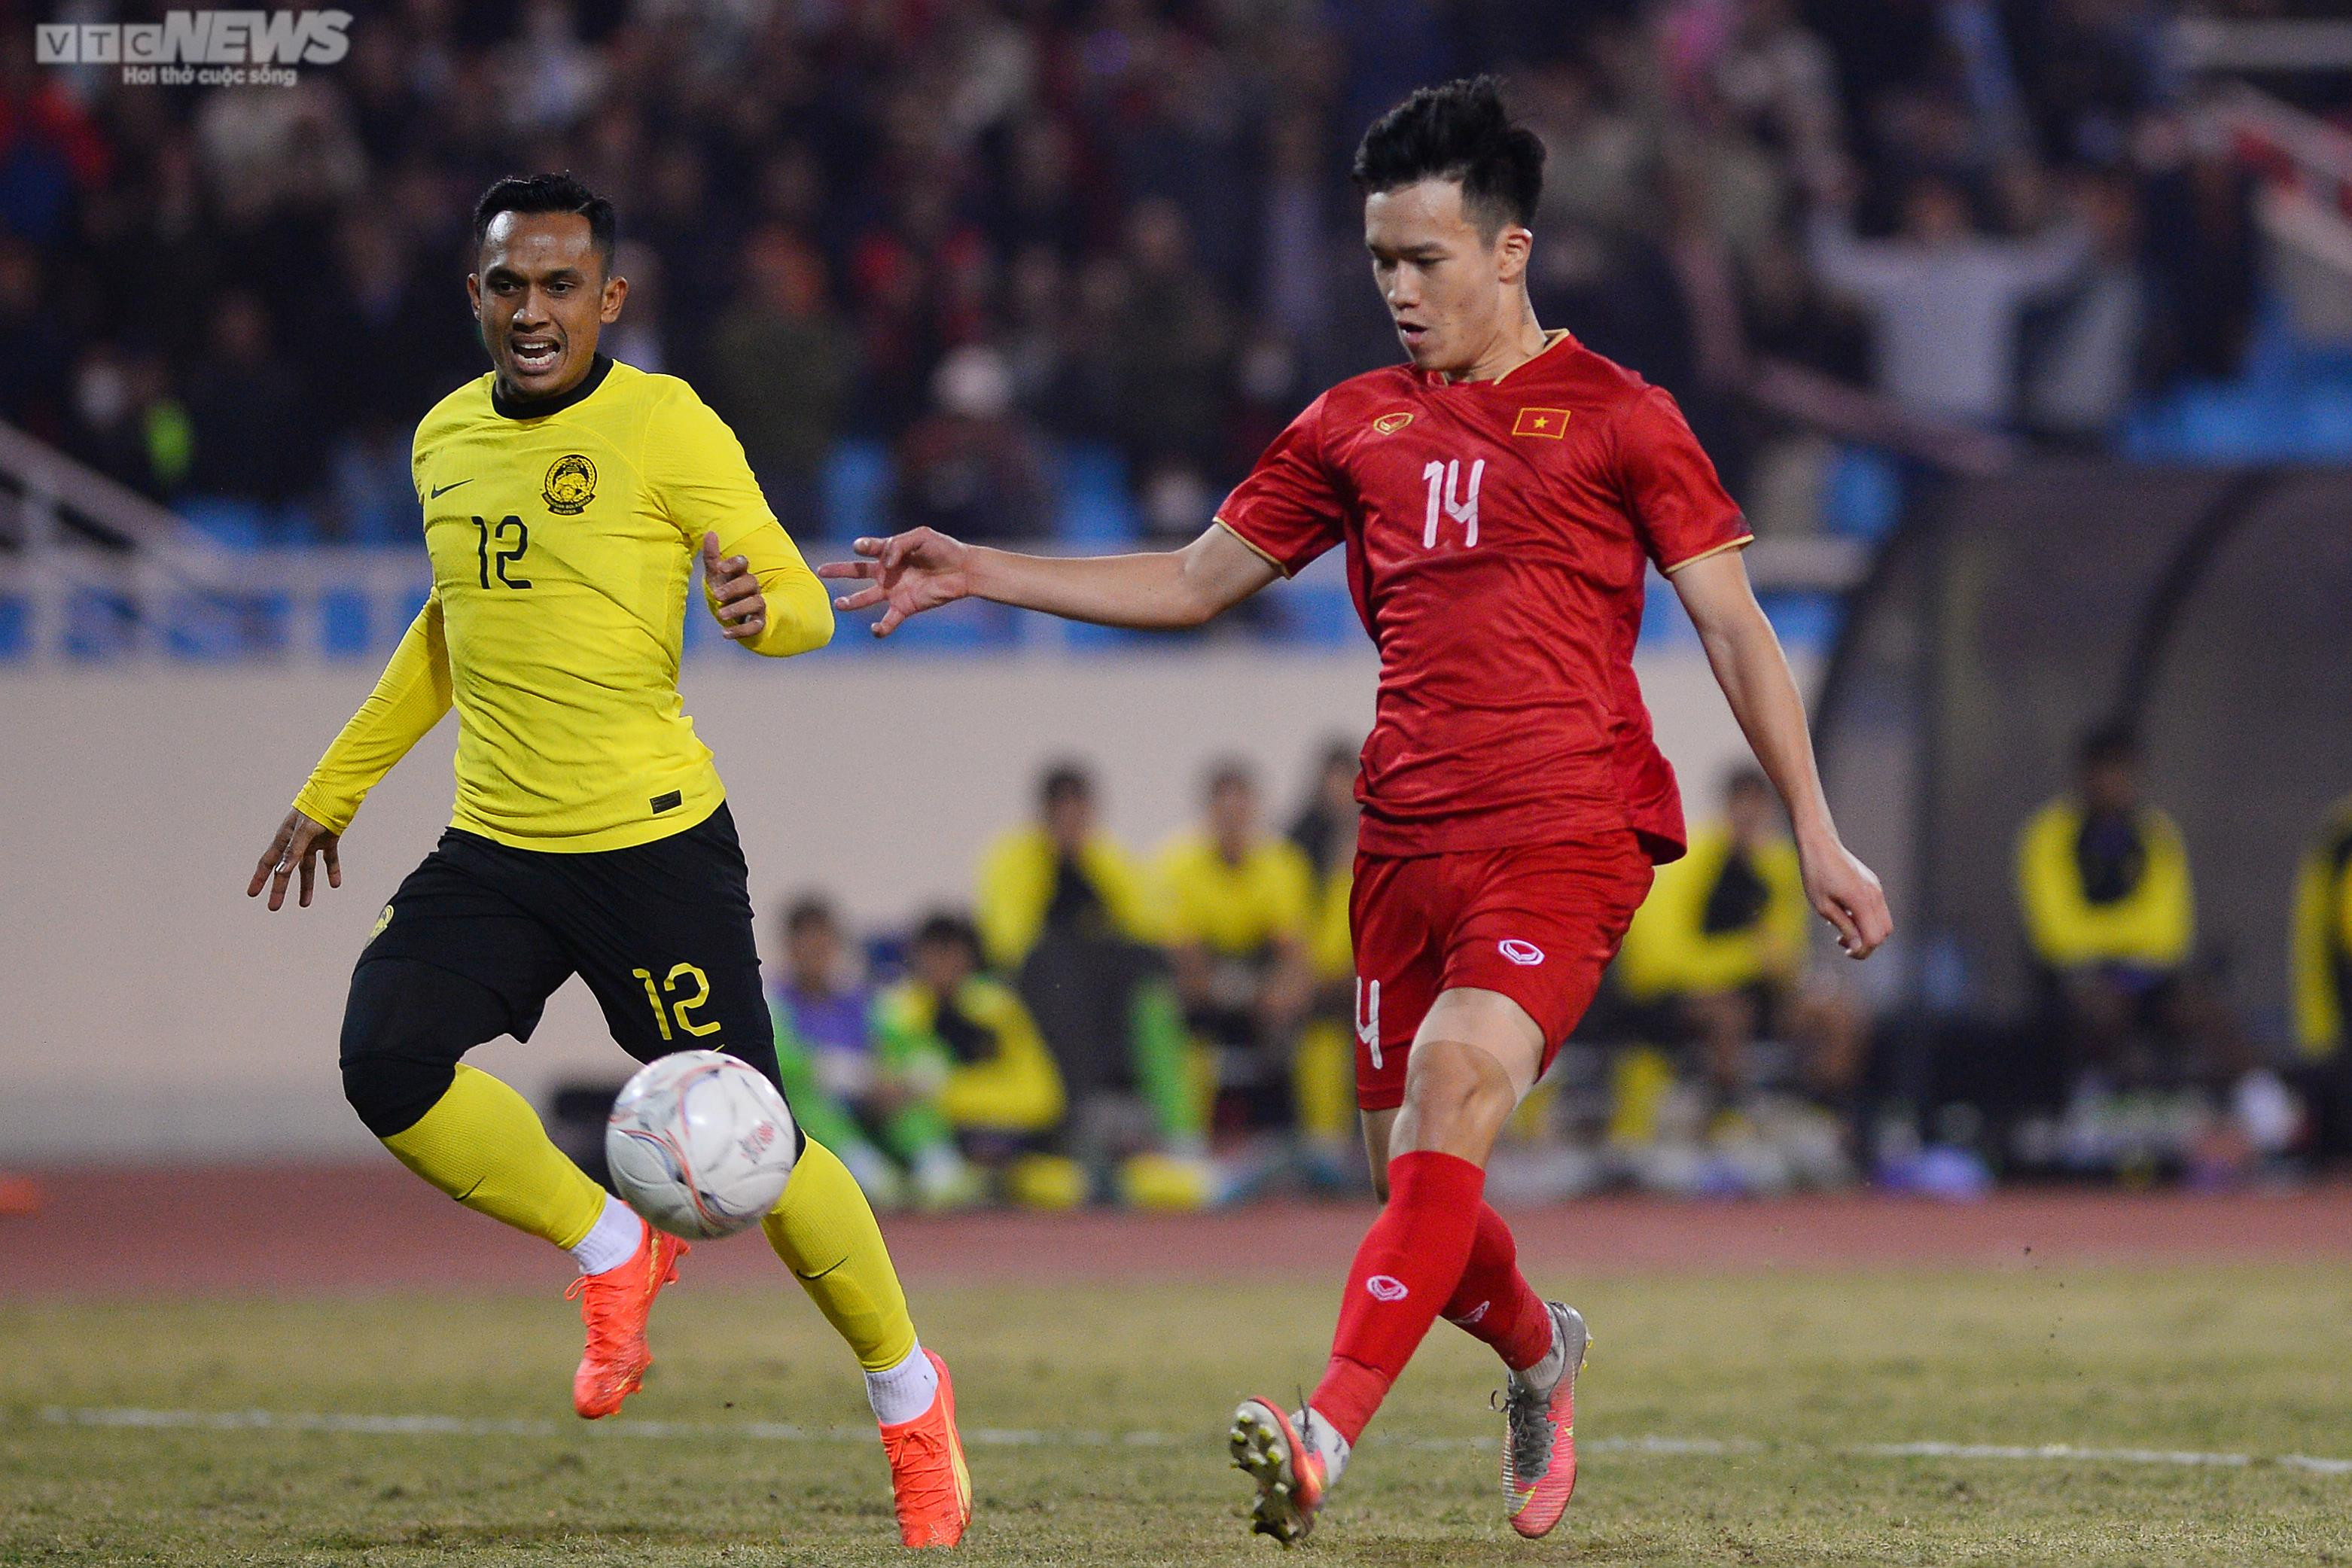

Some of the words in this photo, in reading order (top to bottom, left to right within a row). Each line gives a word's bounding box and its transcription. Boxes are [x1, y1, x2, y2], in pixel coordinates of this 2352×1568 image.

[1422, 459, 1485, 549] 14
[471, 516, 532, 589] 12
[632, 962, 721, 1040] 12
